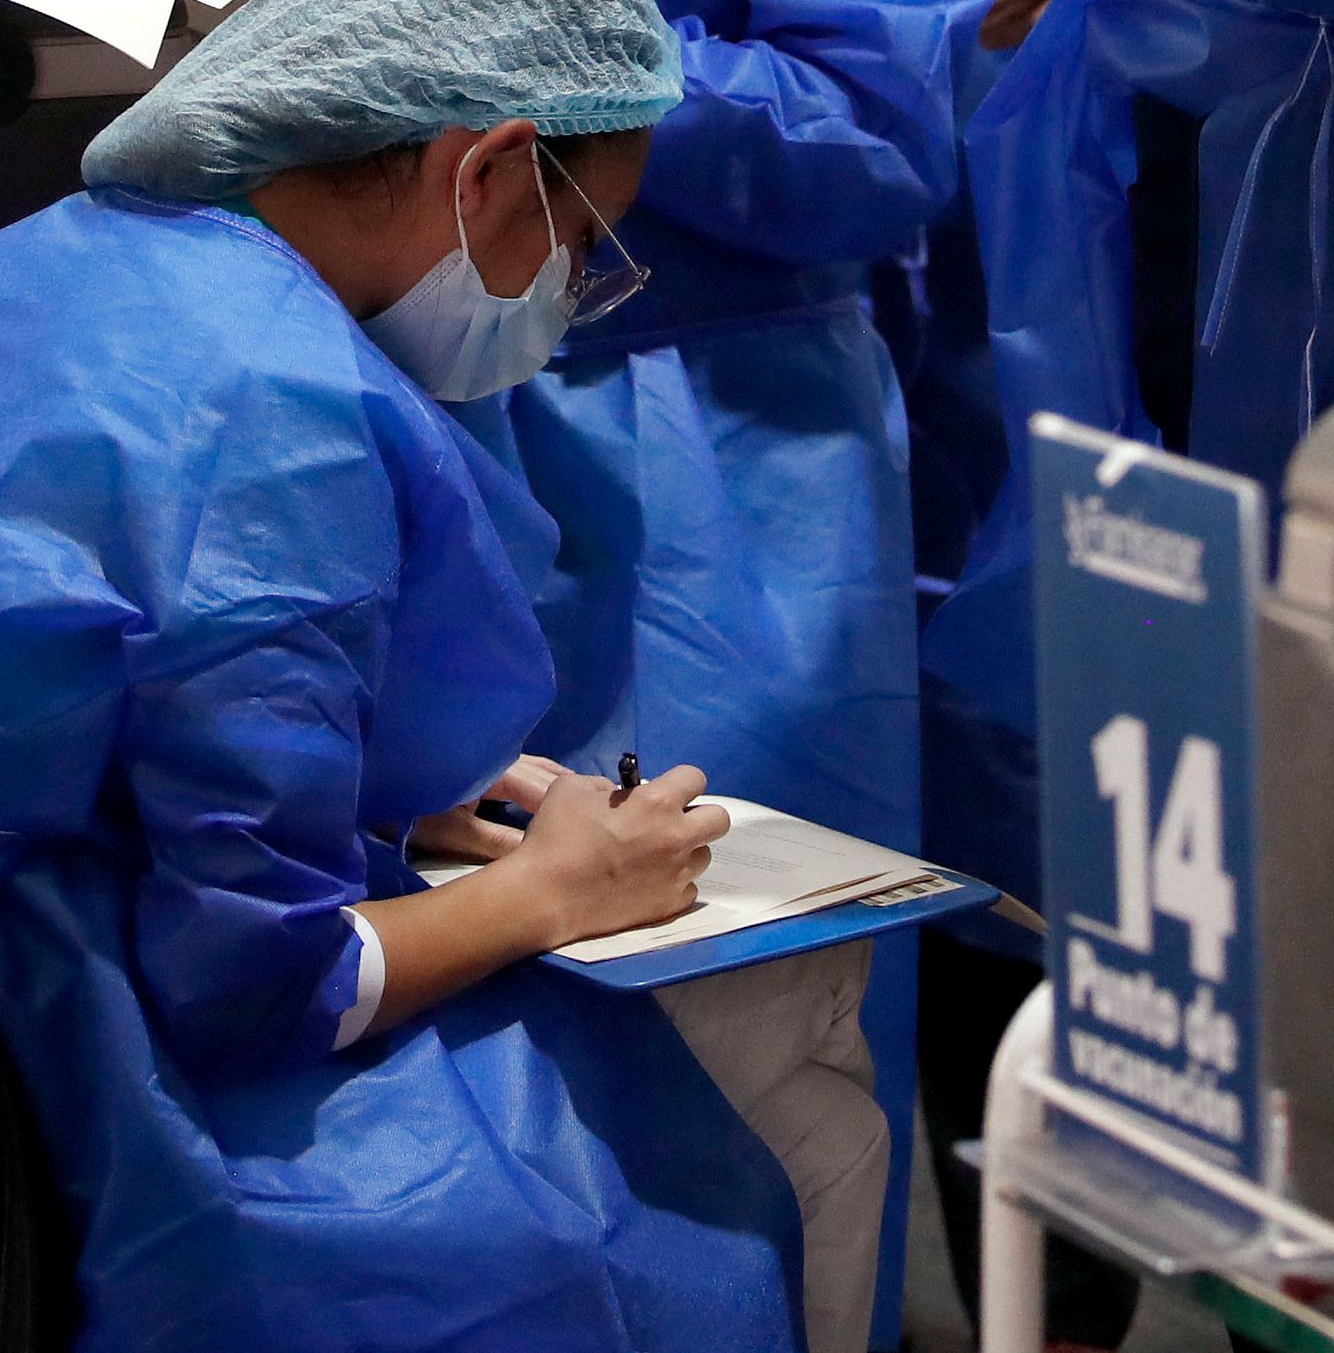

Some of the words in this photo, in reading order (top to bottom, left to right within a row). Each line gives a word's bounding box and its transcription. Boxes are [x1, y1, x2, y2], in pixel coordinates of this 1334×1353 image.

[1090, 712, 1237, 985] 14
[1067, 936, 1179, 1049] Punto
[1184, 984, 1238, 1075] de
